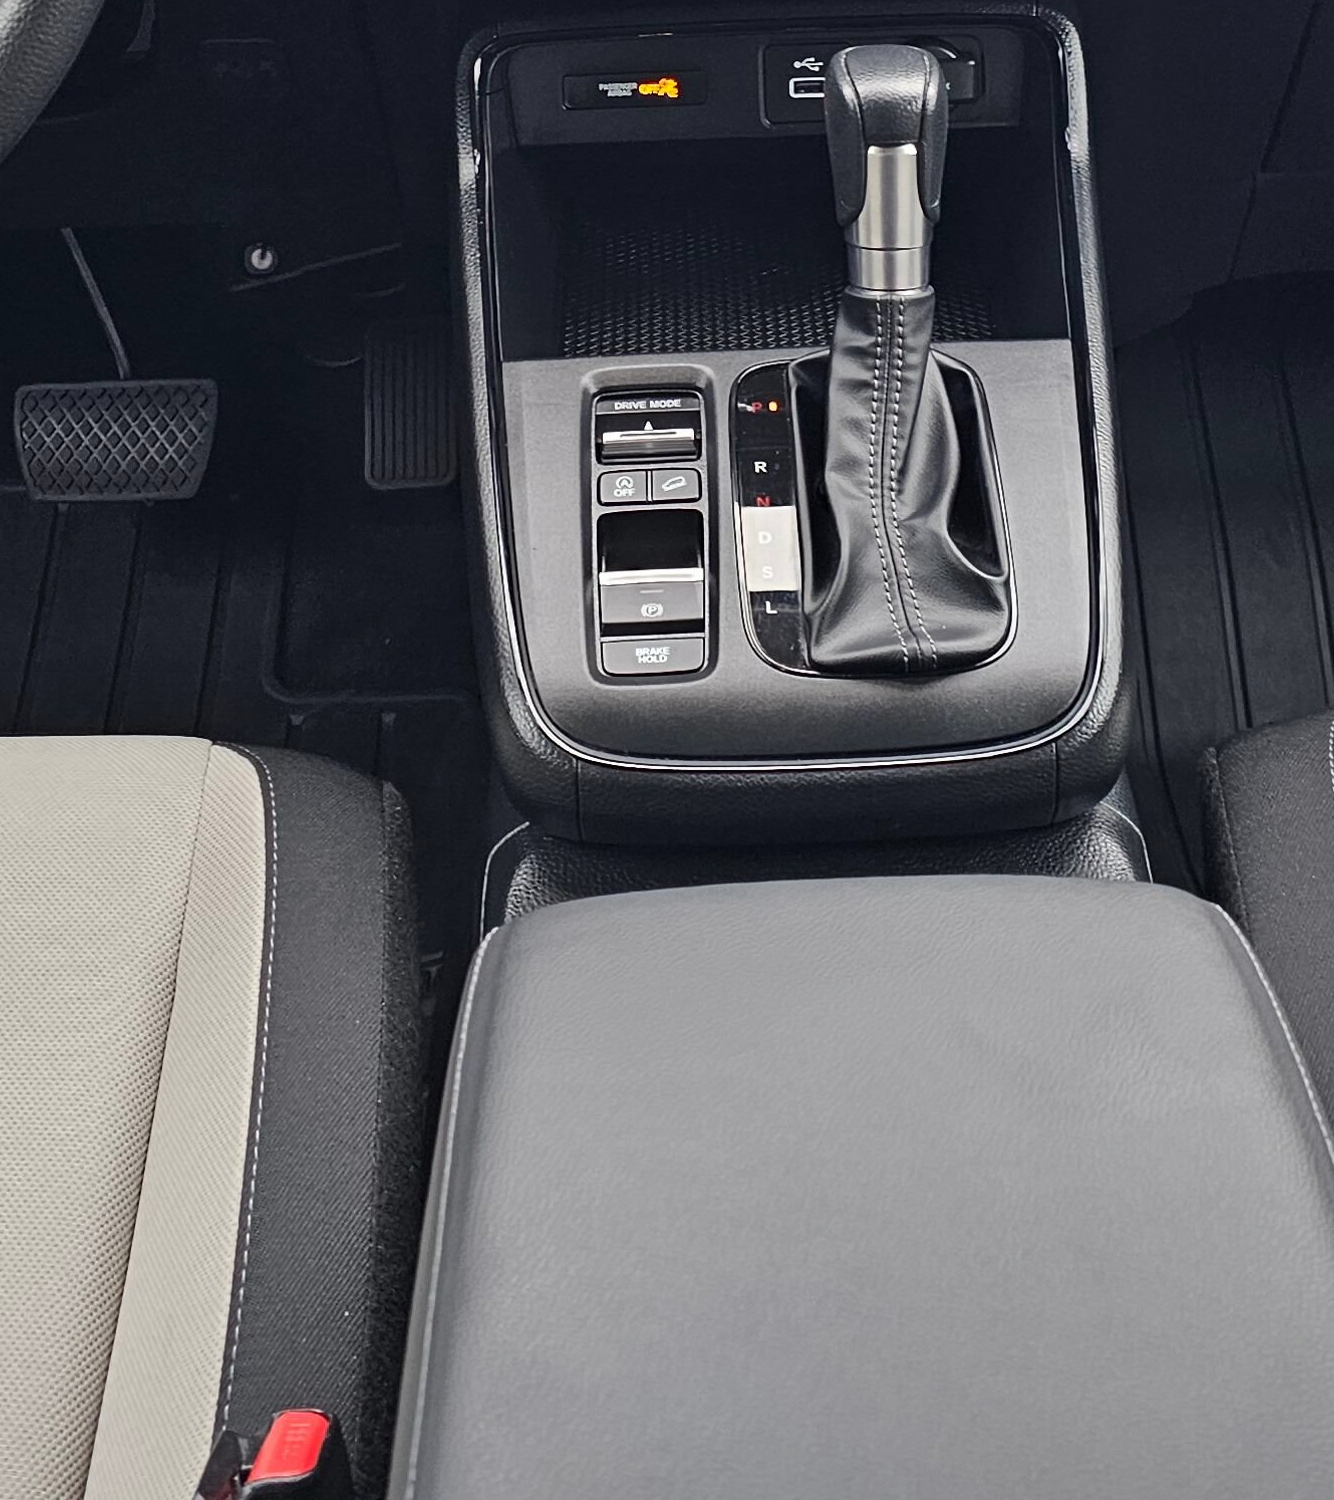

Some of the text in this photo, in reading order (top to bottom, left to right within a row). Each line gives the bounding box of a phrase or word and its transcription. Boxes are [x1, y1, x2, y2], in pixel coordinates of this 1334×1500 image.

[614, 399, 682, 410] DRIVE MODE
[751, 402, 763, 413] P
[753, 461, 768, 473] R
[613, 488, 636, 497] OFF
[756, 496, 771, 507] N
[758, 531, 773, 544] D
[762, 565, 774, 579] S
[765, 600, 778, 615] L
[636, 647, 670, 657] BRAKE
[638, 656, 668, 664] HOLD
